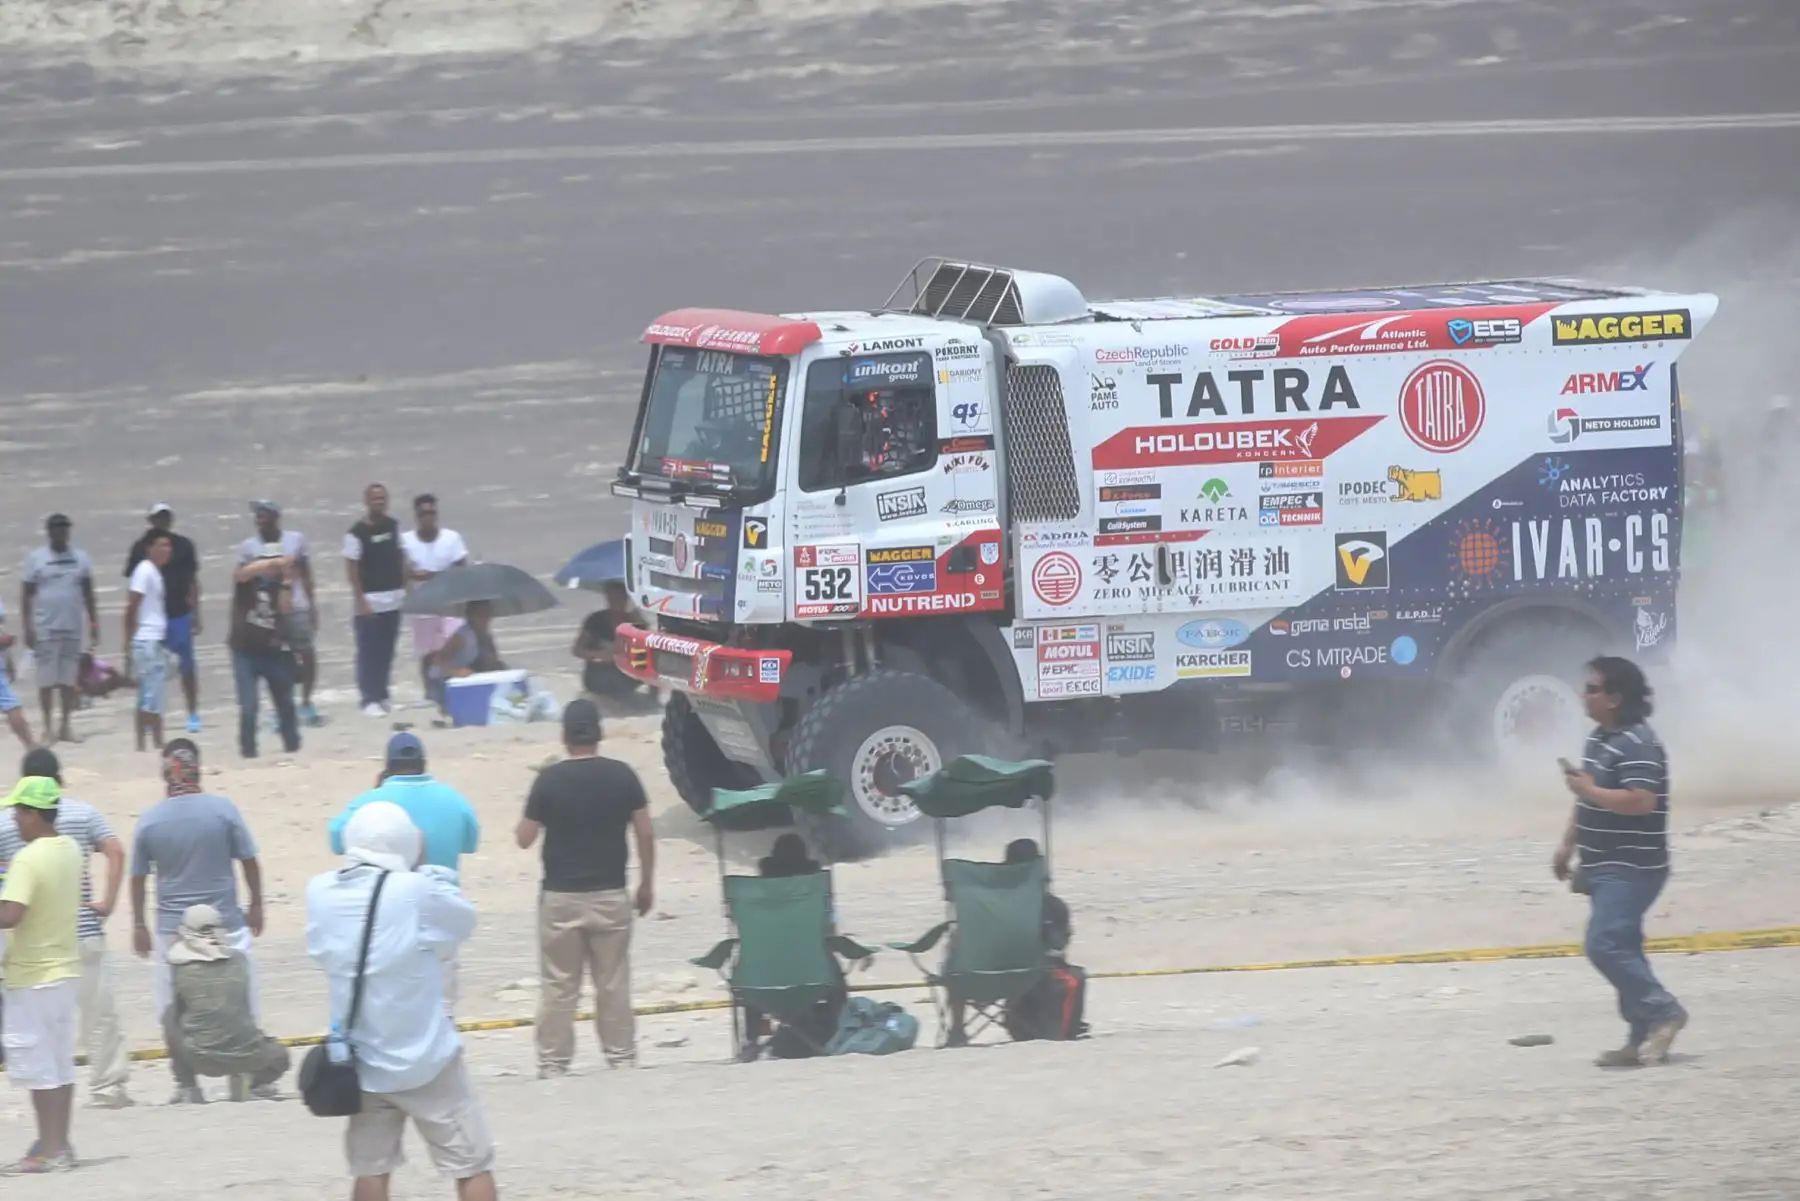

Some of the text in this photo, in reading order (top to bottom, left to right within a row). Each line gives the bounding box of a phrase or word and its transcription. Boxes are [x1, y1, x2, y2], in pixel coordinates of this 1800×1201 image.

[1381, 329, 1427, 339] Atlantic
[1473, 319, 1520, 337] ECS
[863, 337, 924, 351] LAMONT
[1209, 338, 1255, 350] GOLD
[1299, 339, 1430, 355] Auto Performance Ltd.
[696, 351, 735, 374] TATRA
[855, 359, 919, 377] unikont
[888, 373, 918, 382] group
[1560, 363, 1655, 395] ARMEX
[1091, 391, 1118, 401] PAME
[1146, 365, 1360, 418] TATRA
[1091, 400, 1119, 411] AUTO
[1415, 371, 1466, 441] TATRA
[1585, 417, 1657, 430] NETO HOLDING
[1135, 428, 1292, 454] HOLOUBEK
[1236, 449, 1295, 458] KONCERN
[1339, 481, 1386, 495] IPODEC
[1560, 473, 1645, 492] ANALYTICS
[1263, 495, 1303, 506] EMPEC
[1559, 487, 1668, 508] DATA FACTORY
[958, 500, 995, 511] Omega
[1180, 507, 1248, 523] KARETA
[1282, 513, 1321, 523] TECHNIK
[805, 568, 852, 600] 532
[900, 573, 935, 581] KOVOS
[1093, 587, 1131, 600] ZERO
[1210, 579, 1291, 594] LUBRICANT
[798, 605, 829, 614] MOTUL
[872, 593, 976, 613] NUTREND
[1291, 611, 1371, 637] gema instal
[1044, 645, 1093, 659] MOTUL
[1286, 646, 1387, 668] CS MTRADE
[1108, 666, 1156, 681] EXIDE
